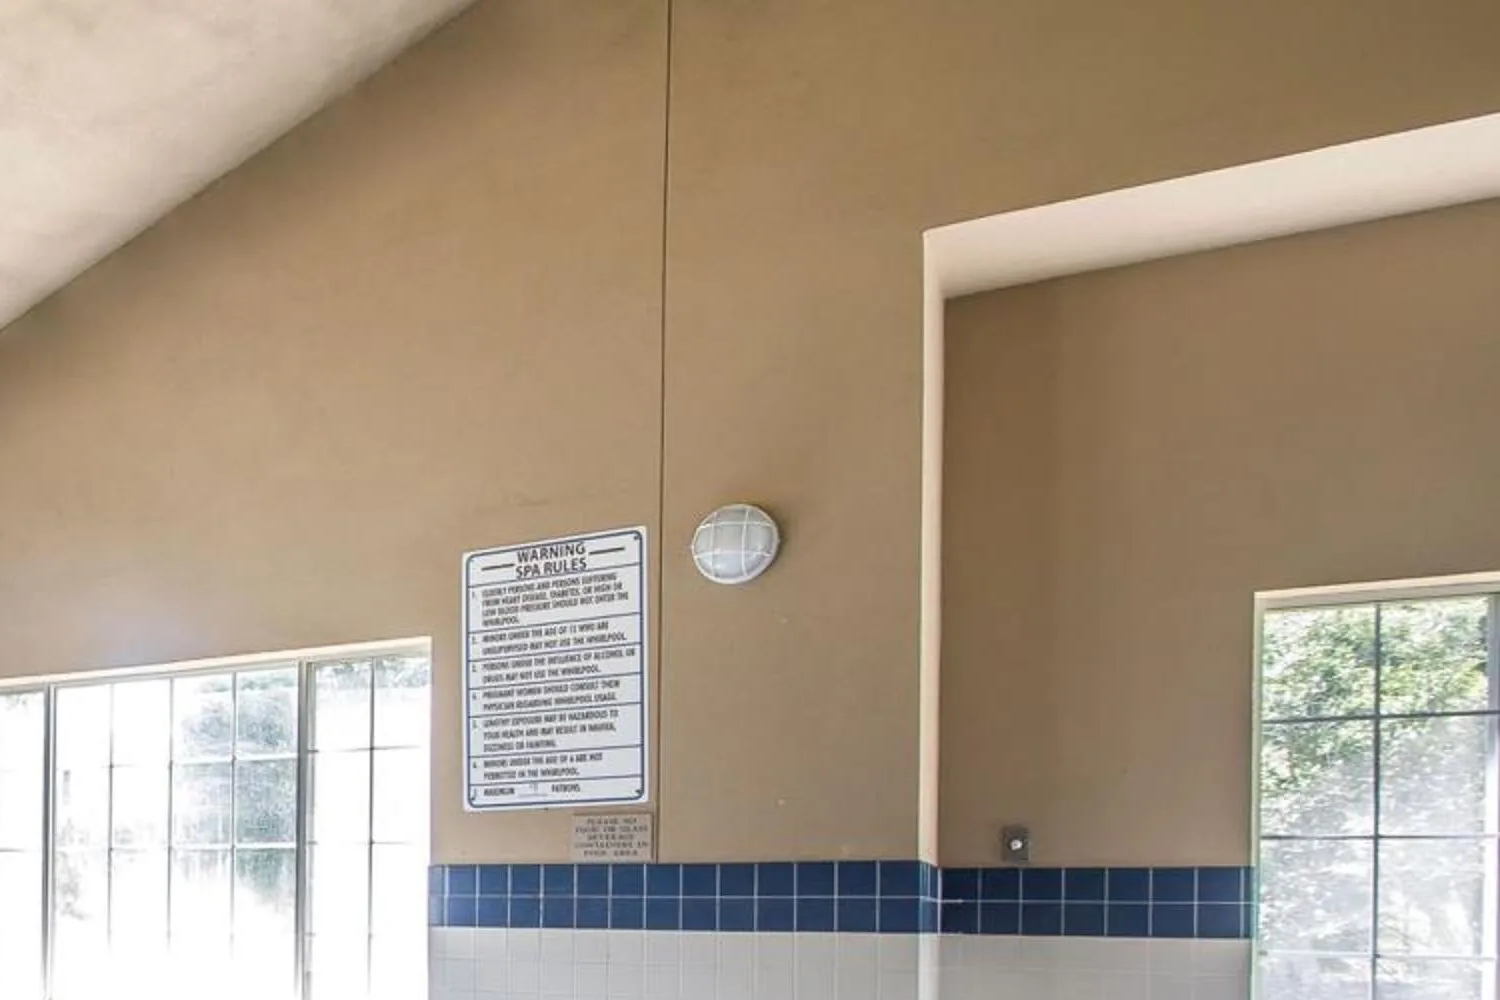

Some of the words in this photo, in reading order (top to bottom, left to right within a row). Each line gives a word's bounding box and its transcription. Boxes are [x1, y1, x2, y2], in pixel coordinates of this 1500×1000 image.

[517, 543, 584, 563] WARNING
[516, 564, 539, 578] SPA
[543, 557, 586, 574] RULES
